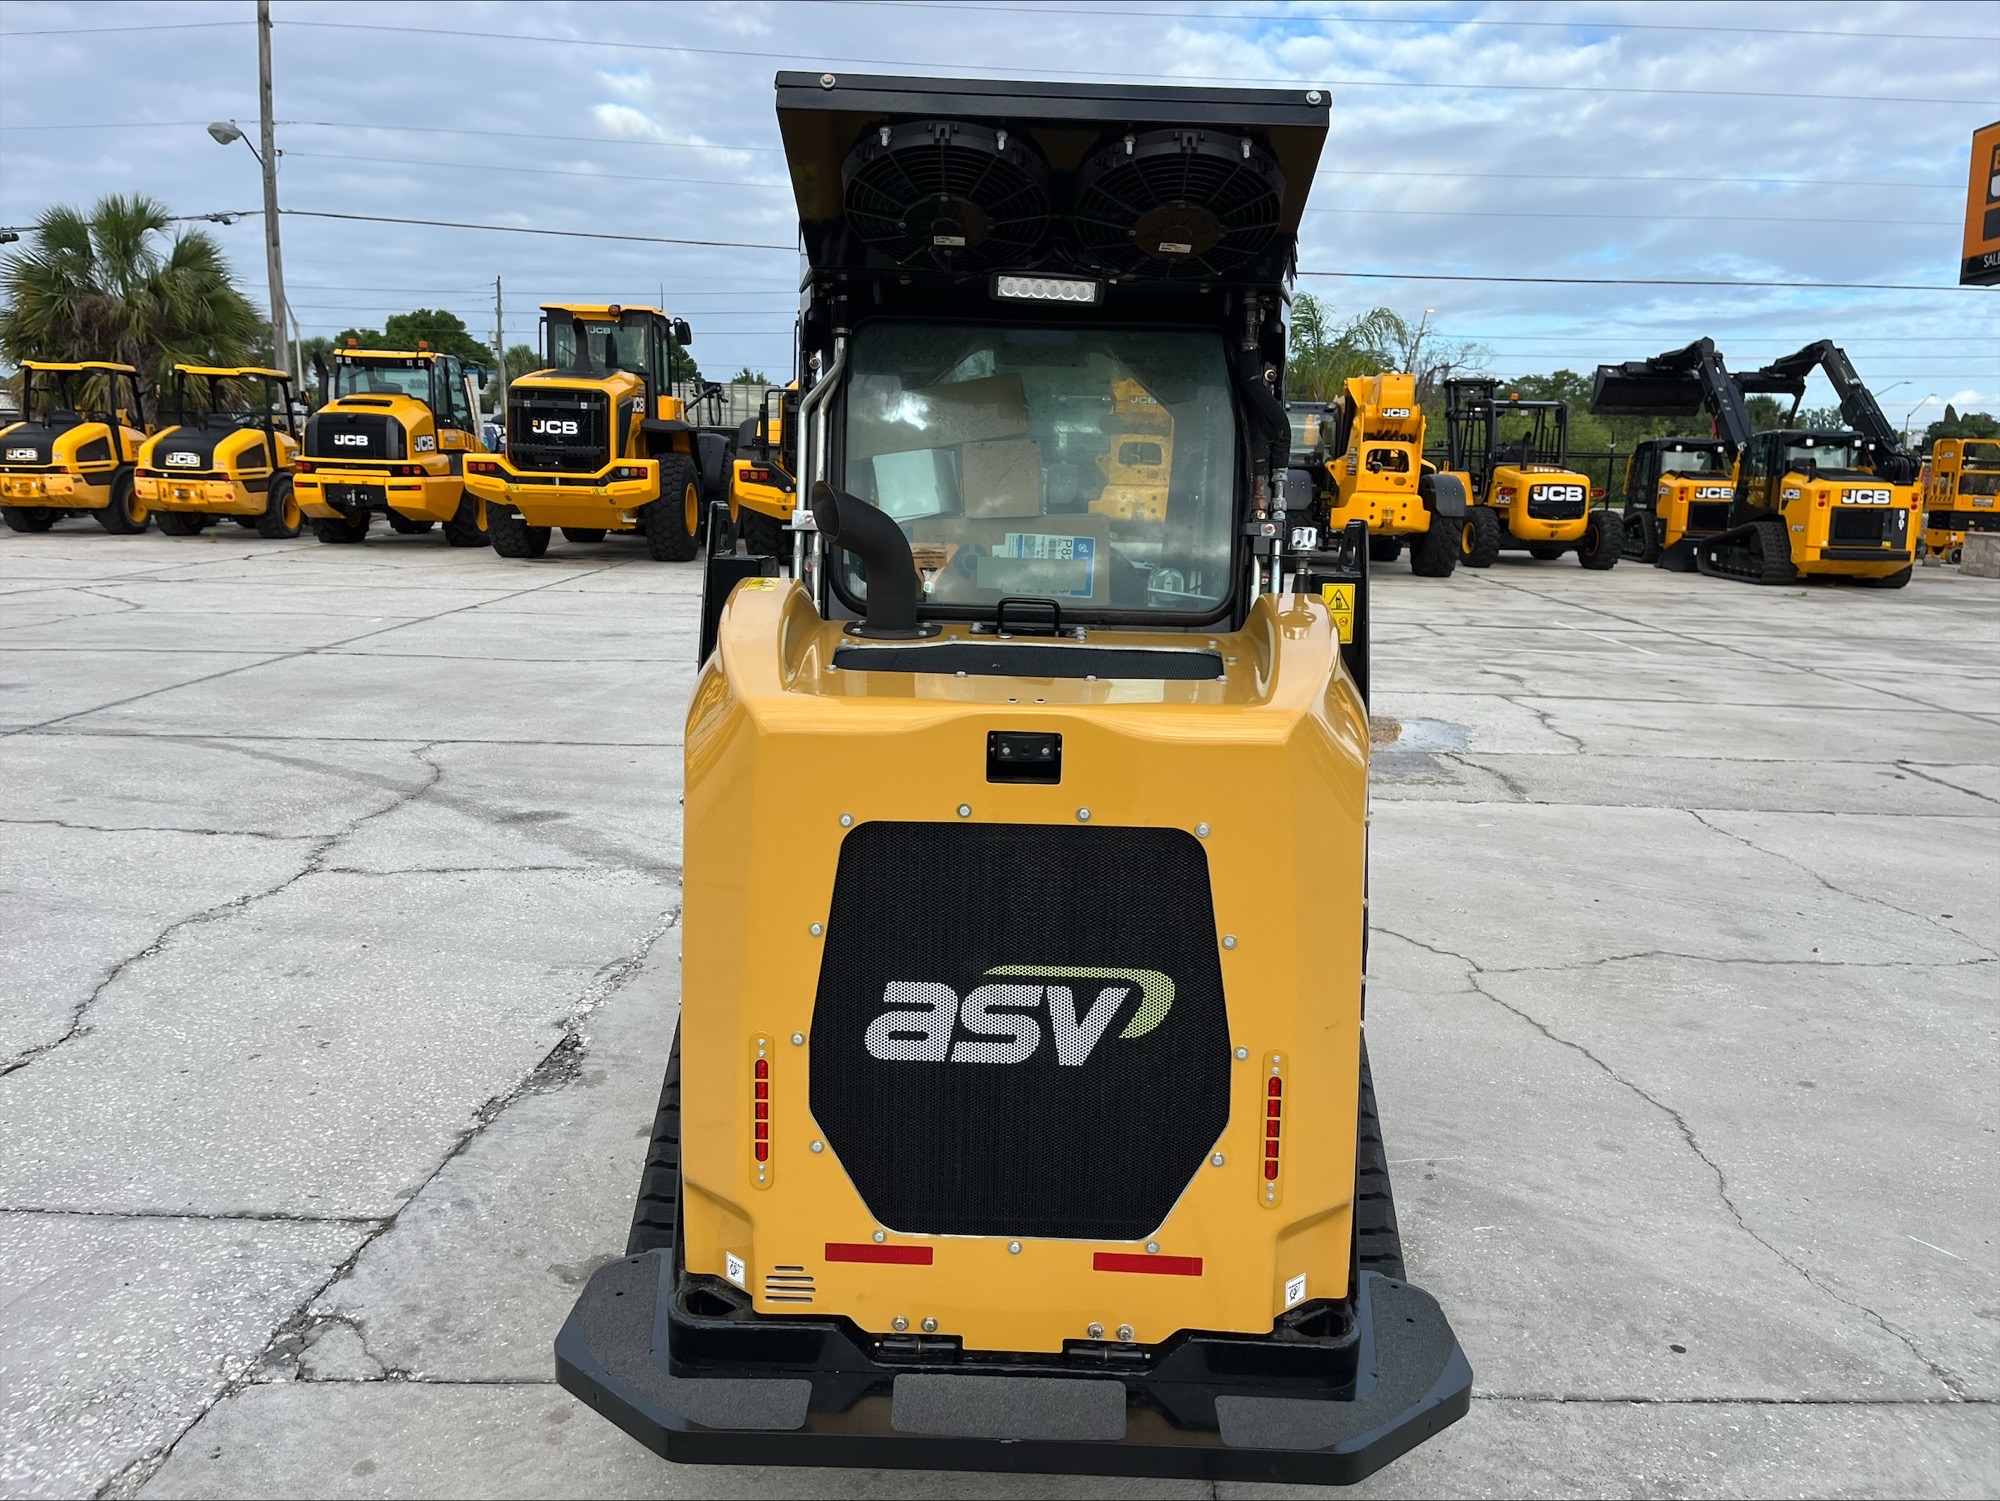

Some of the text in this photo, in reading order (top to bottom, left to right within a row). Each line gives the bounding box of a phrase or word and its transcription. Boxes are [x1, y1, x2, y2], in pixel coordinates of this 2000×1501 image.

[1130, 396, 1157, 404] JCB
[1382, 408, 1410, 417] JCB
[532, 420, 578, 435] JCB
[334, 434, 368, 446] JCB
[414, 435, 435, 451] JCB
[7, 449, 37, 459] JCB
[167, 455, 198, 464] JCB
[1533, 486, 1583, 501] JCB
[1782, 488, 1800, 499] JCB
[1842, 489, 1890, 504] JCB
[864, 981, 1130, 1066] asv
